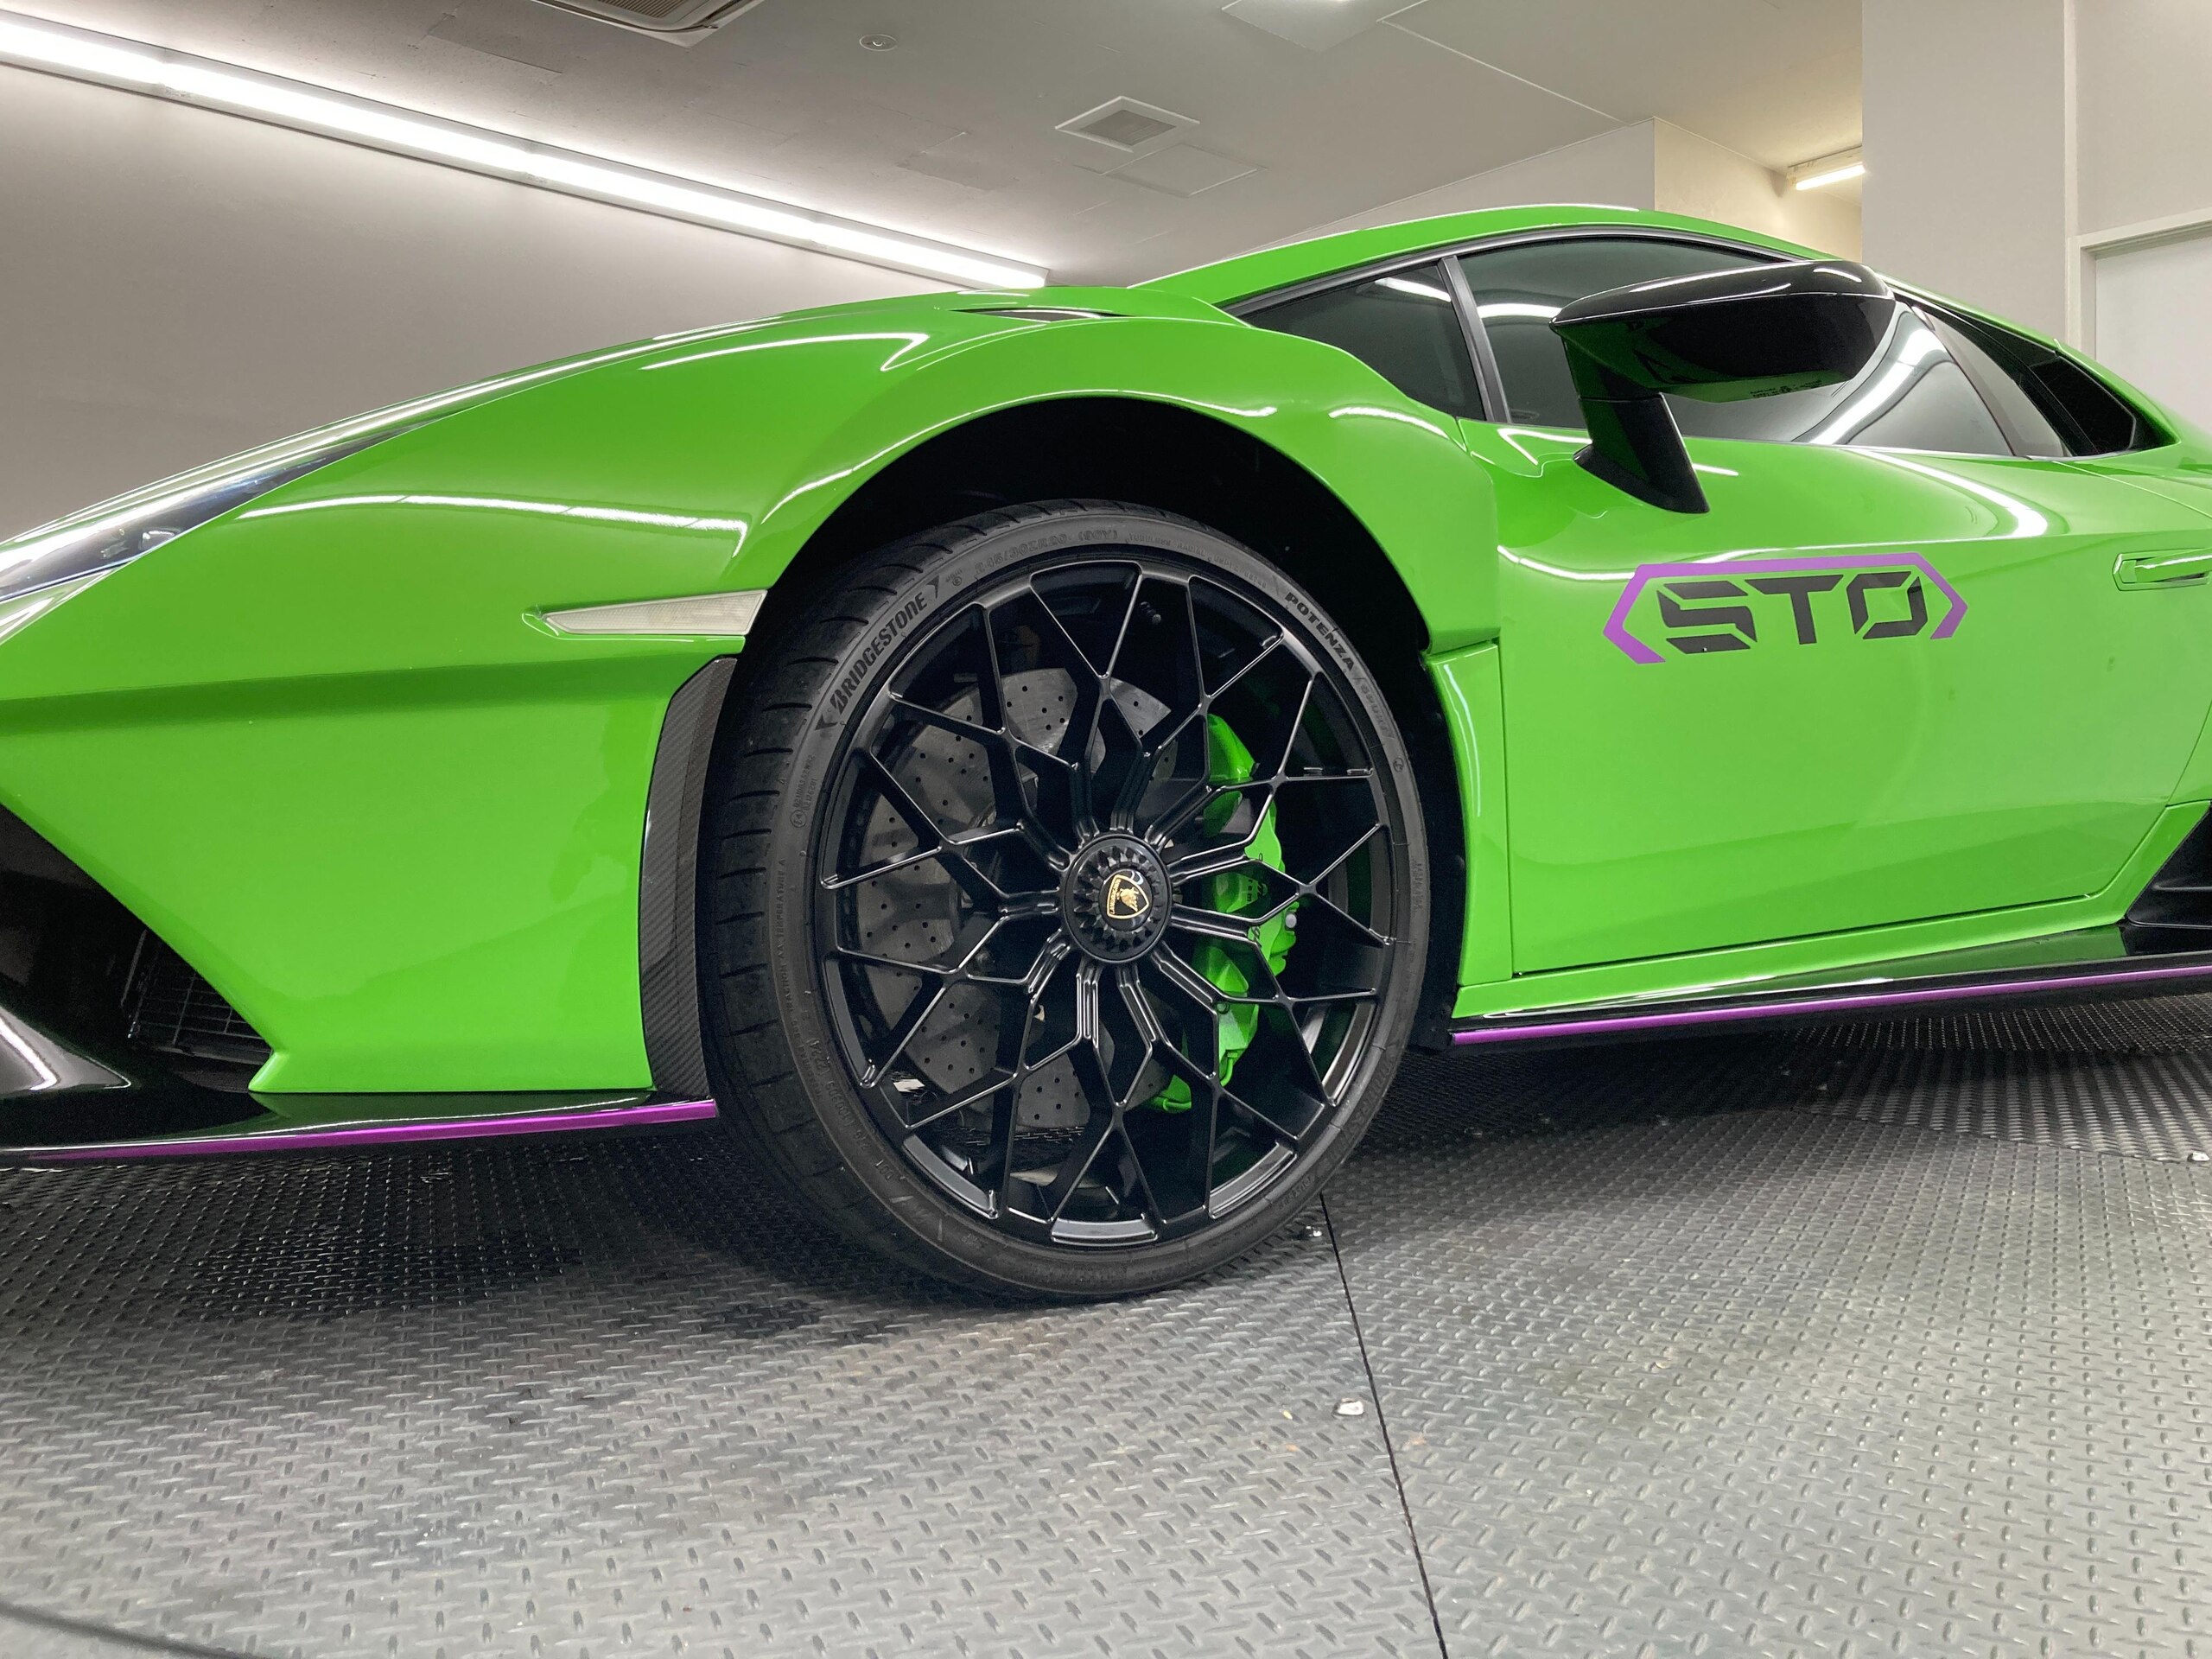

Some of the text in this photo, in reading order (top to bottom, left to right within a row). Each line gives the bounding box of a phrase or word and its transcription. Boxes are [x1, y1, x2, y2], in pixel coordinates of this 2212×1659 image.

[1285, 592, 1355, 672] POTENZA
[1656, 571, 1929, 654] STO
[830, 593, 928, 715] BRIDGESTONE
[873, 1158, 895, 1182] DOT
